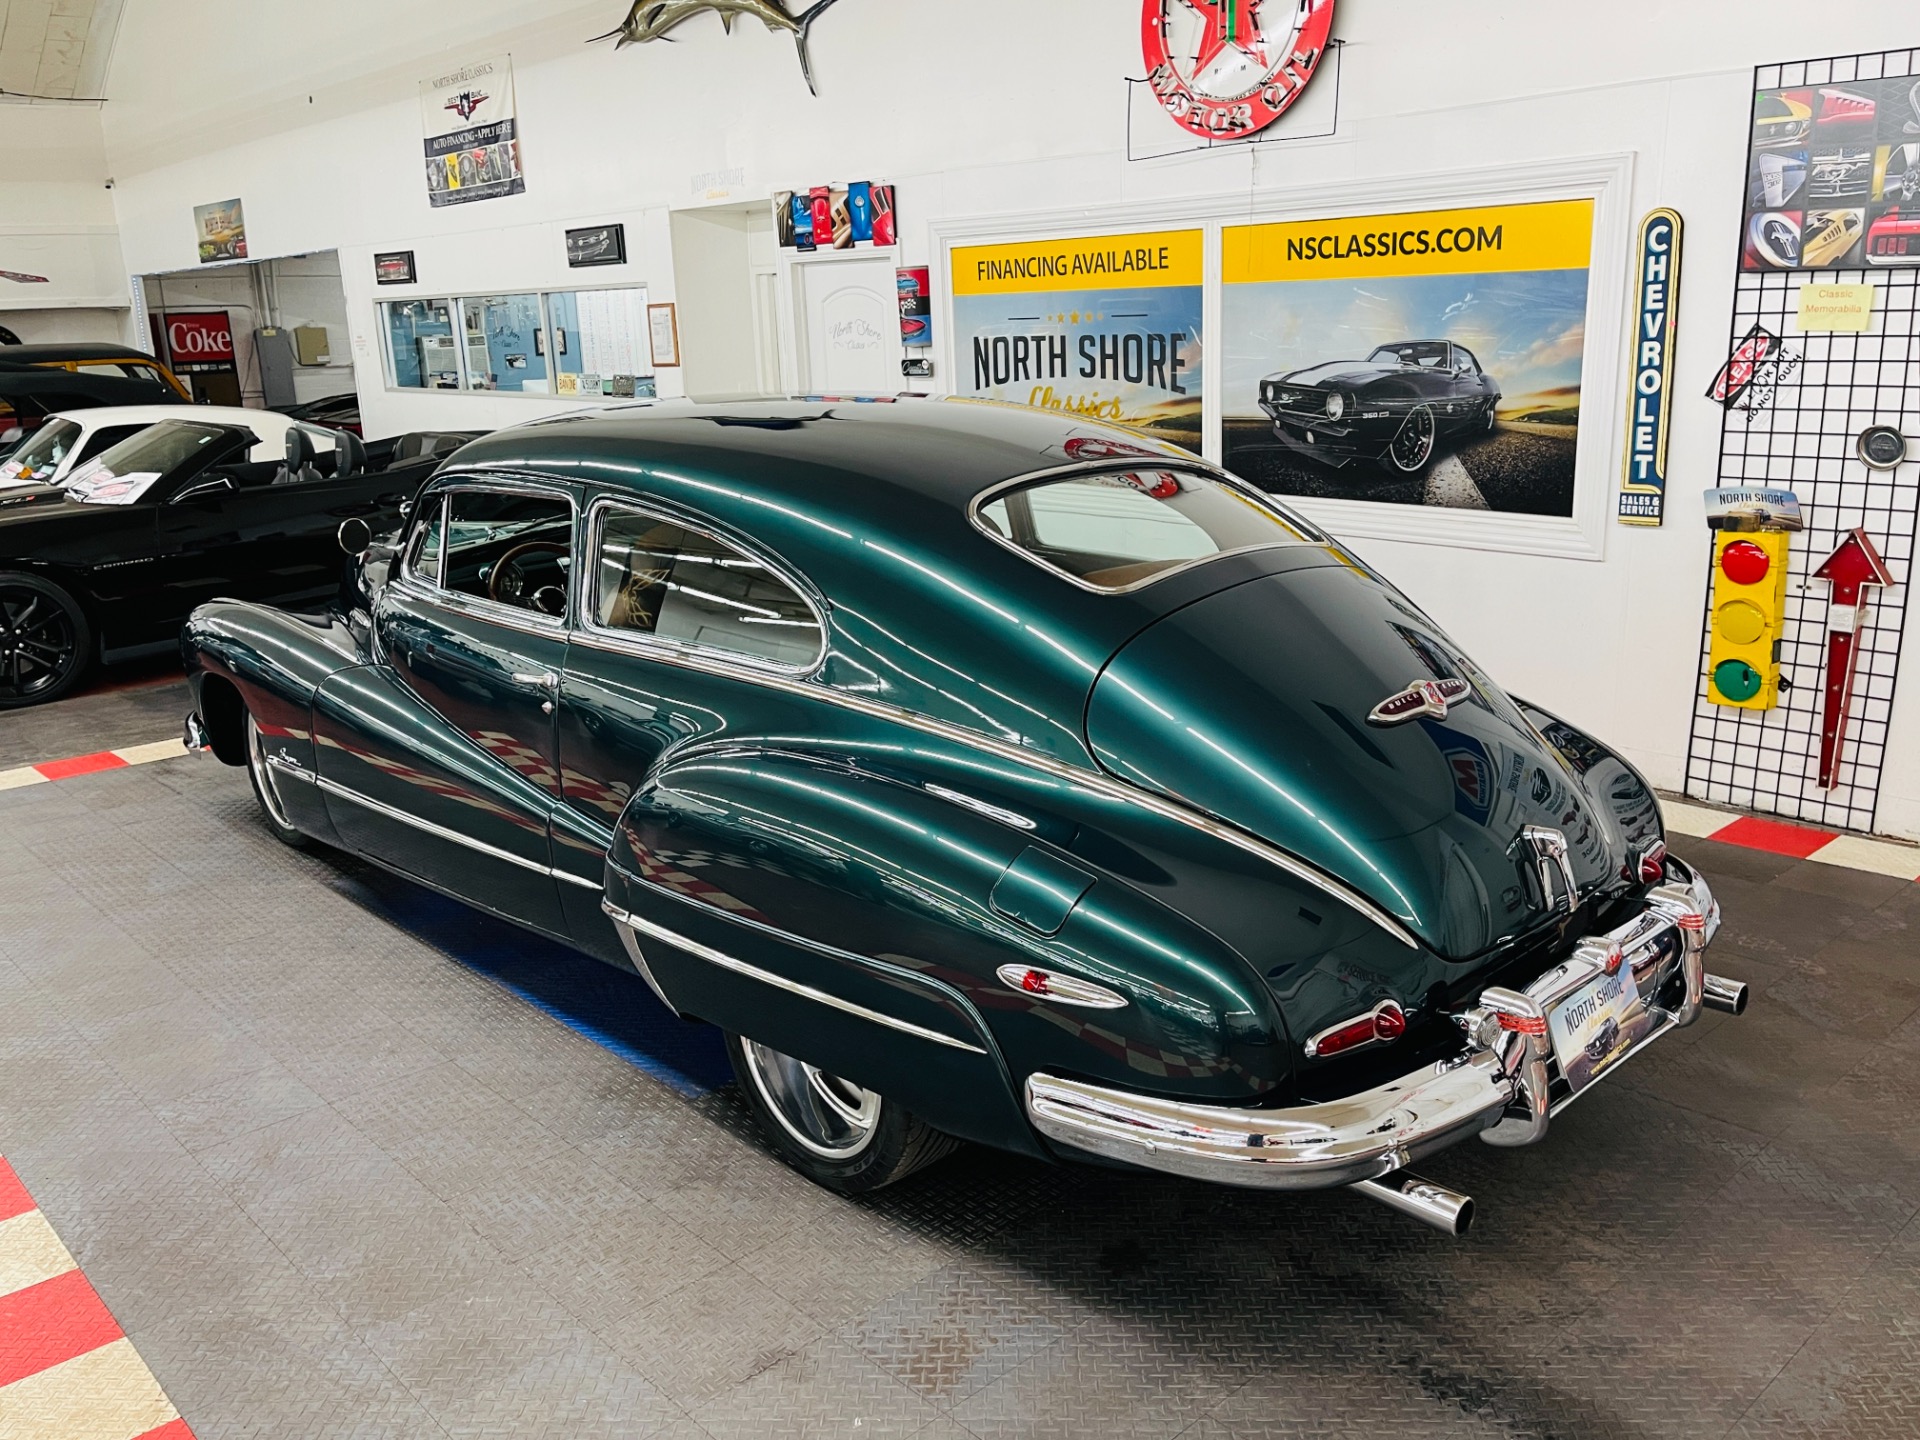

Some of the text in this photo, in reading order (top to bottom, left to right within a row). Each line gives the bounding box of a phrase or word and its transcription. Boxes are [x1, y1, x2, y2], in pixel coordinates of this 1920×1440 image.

[432, 63, 493, 89] NORTH SHORE CLASSICS
[1149, 49, 1319, 135] MOTOR OIL
[433, 139, 447, 150] AUTO
[447, 131, 475, 146] FINANCING
[478, 127, 495, 139] APPLY
[496, 122, 511, 135] HERE
[691, 167, 746, 195] NORTH SHORE
[1287, 225, 1502, 261] NSCLASSICS.COM
[977, 247, 1169, 281] FINANCING AVAILABLE
[1818, 289, 1854, 299] Classic
[1805, 304, 1862, 314] Memorabilia
[169, 322, 232, 353] Coke
[1633, 225, 1670, 479] CHEVROLET
[973, 333, 1187, 395] NORTH SHORE
[1028, 386, 1124, 420] Classics
[1746, 409, 1759, 422] DO
[1757, 387, 1774, 409] NOT
[1620, 505, 1660, 515] SERVICE
[1621, 495, 1660, 505] SALES &
[1719, 493, 1786, 507] NORTH SHORE
[1388, 693, 1419, 709] BUICK
[1564, 977, 1624, 1036] NORTH SHORE
